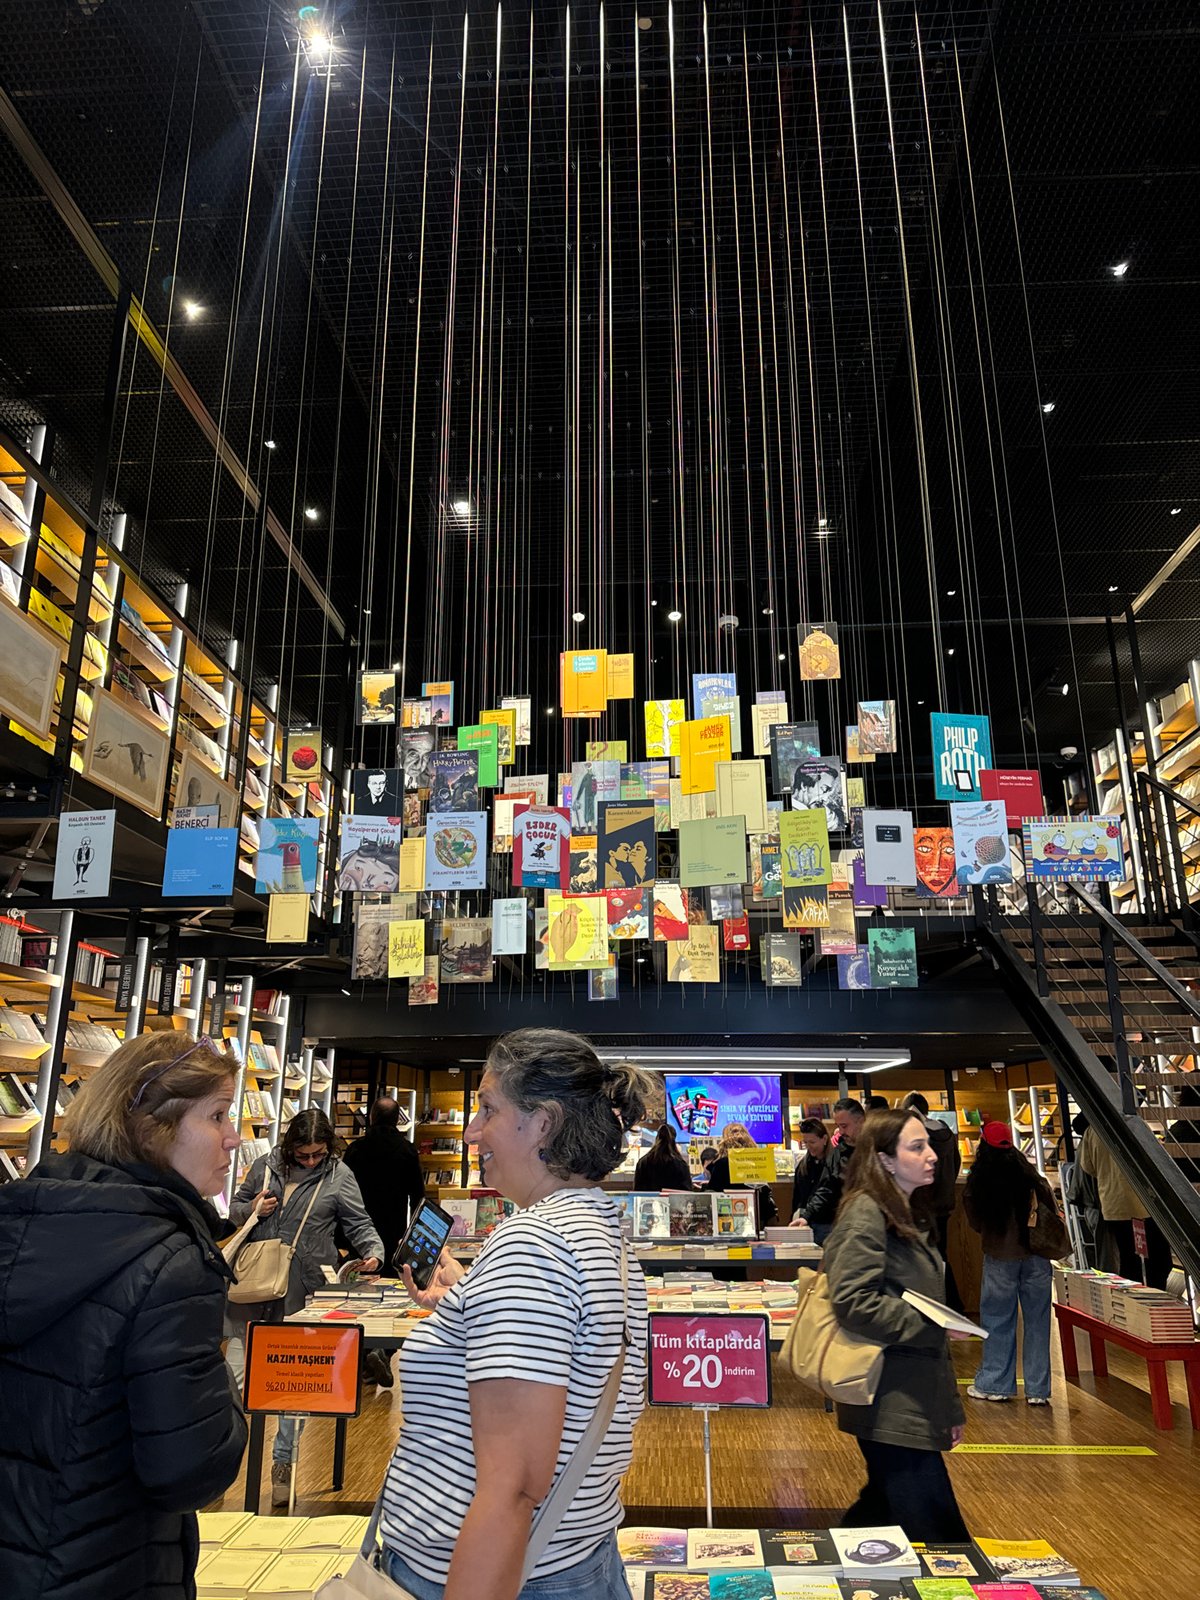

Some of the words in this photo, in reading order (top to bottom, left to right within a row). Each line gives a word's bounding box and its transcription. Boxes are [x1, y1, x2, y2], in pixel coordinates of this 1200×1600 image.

[943, 726, 979, 751] PHILIP
[940, 747, 986, 787] ROTH
[525, 820, 557, 832] EJDER
[525, 831, 557, 842] ÇOCUK
[802, 905, 830, 925] KAFKA
[737, 1104, 747, 1113] VE
[727, 1113, 750, 1122] DEVAM
[652, 1333, 682, 1349] Tüm
[686, 1333, 761, 1353] kitaplarda
[266, 1354, 296, 1365] KAZIM
[298, 1355, 336, 1367] TAŞKENT
[663, 1354, 723, 1389] %20
[724, 1366, 756, 1376] indirim
[265, 1381, 285, 1392] %20
[287, 1380, 333, 1393] İNDİRİMLİ
